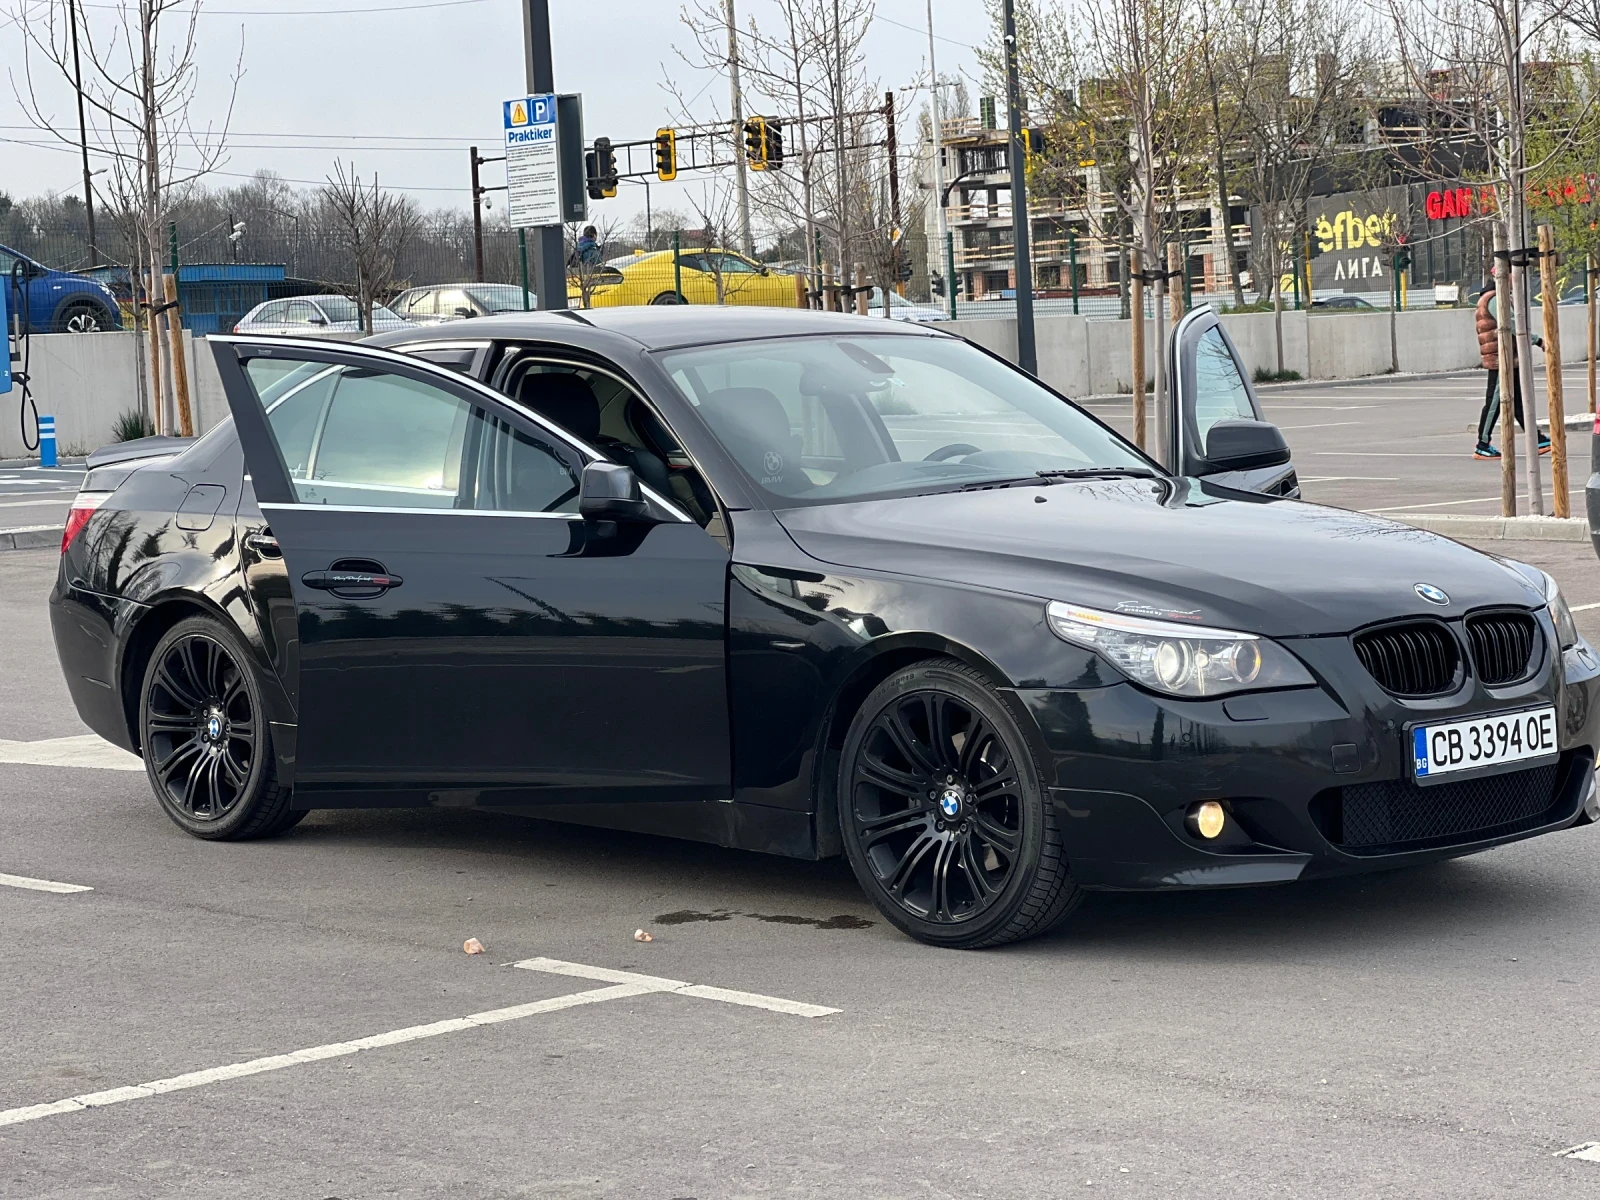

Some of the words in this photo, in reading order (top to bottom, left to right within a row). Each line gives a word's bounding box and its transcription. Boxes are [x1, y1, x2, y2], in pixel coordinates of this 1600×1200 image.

[535, 102, 545, 120] P
[508, 128, 552, 143] Praktiker
[1335, 256, 1383, 280] ЛИГА
[761, 475, 784, 484] BMW
[1432, 729, 1463, 767] CB
[1469, 719, 1522, 761] 3394
[1416, 757, 1428, 769] BG
